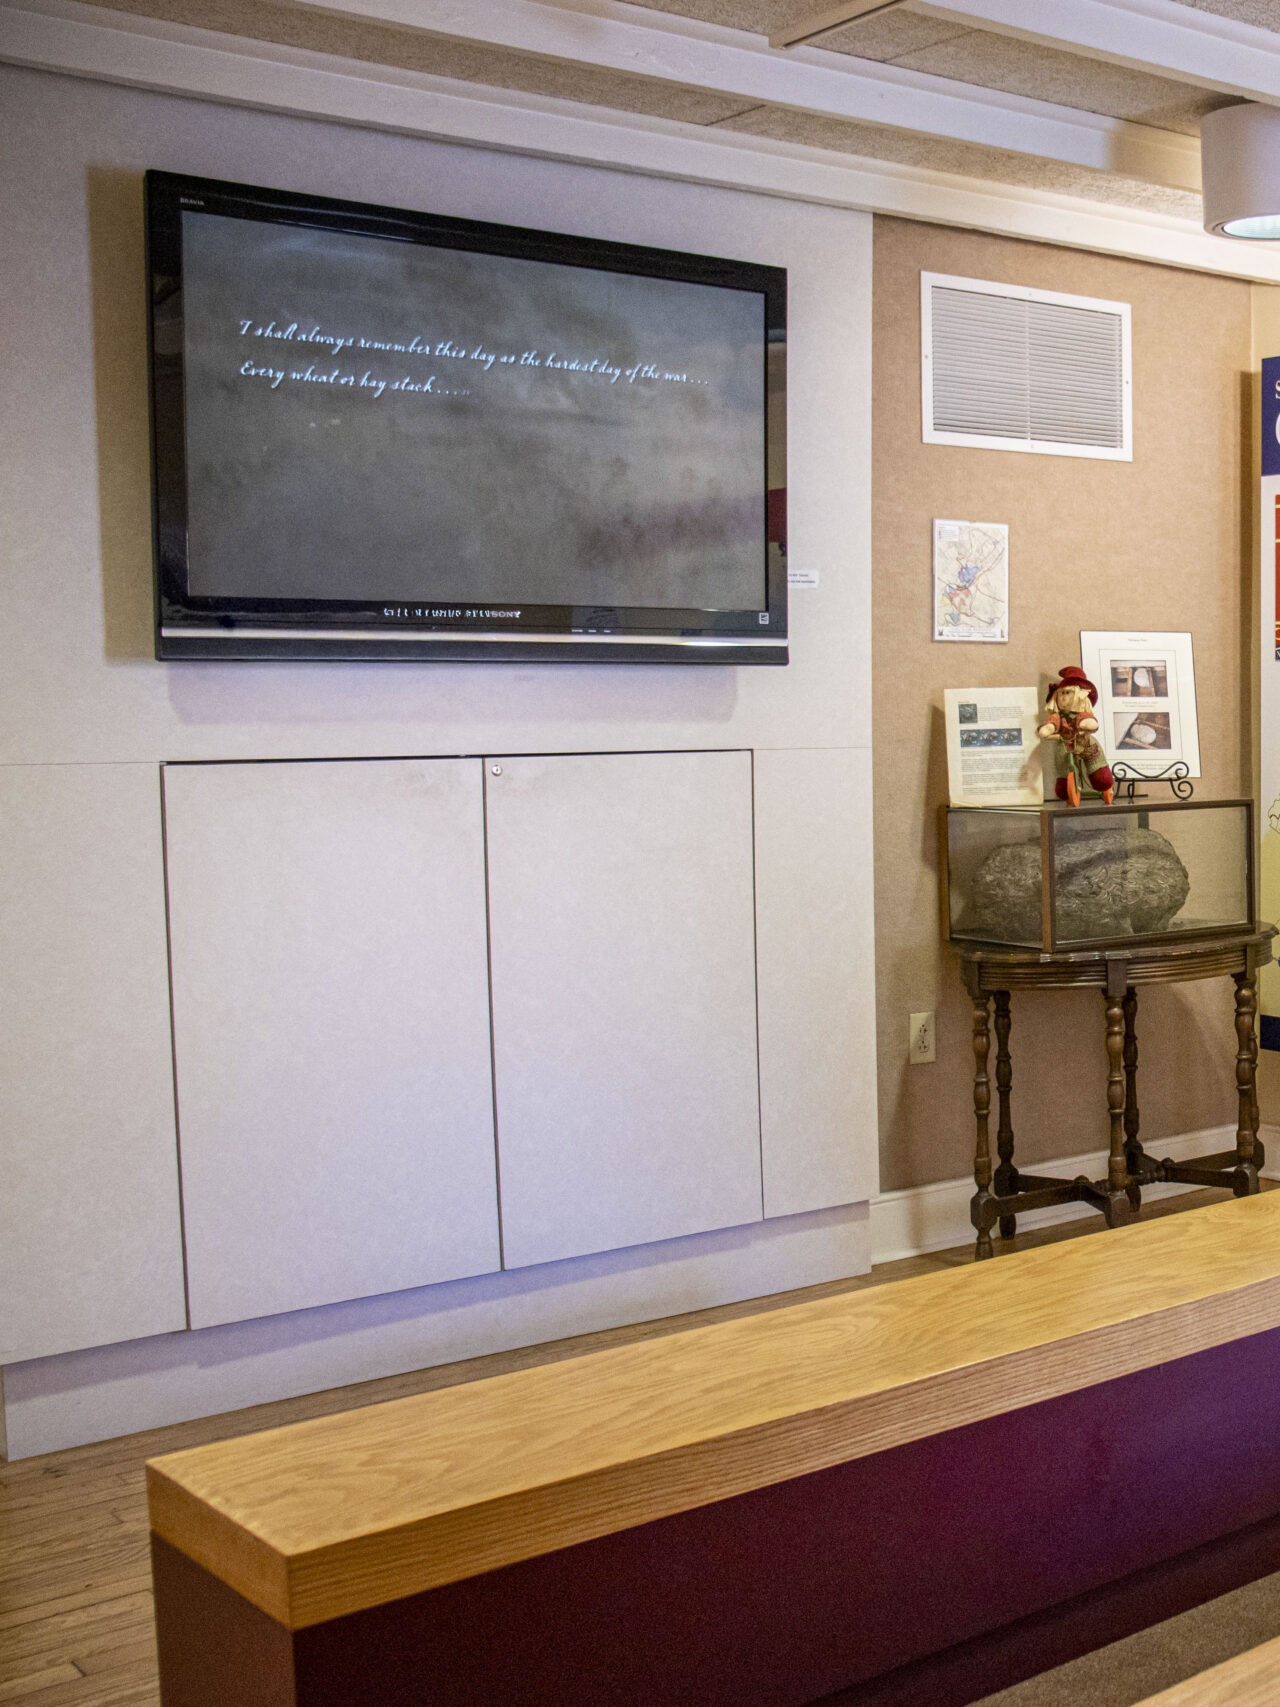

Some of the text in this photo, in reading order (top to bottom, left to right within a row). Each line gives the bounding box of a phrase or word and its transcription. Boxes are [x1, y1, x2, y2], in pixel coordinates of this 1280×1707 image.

[180, 198, 205, 206] BRAVIA
[255, 321, 297, 341] shall
[297, 326, 355, 356] always
[358, 336, 432, 357] remember
[435, 341, 466, 360] this
[469, 345, 496, 371] day
[500, 354, 516, 364] as
[520, 350, 541, 367] the
[545, 353, 600, 373] hardest
[600, 359, 622, 384] day
[625, 362, 643, 384] of
[640, 364, 661, 380] the
[240, 359, 285, 389] Every
[291, 365, 340, 385] wheat
[340, 374, 356, 388] or
[359, 370, 387, 399] hay
[491, 610, 521, 618] SONY
